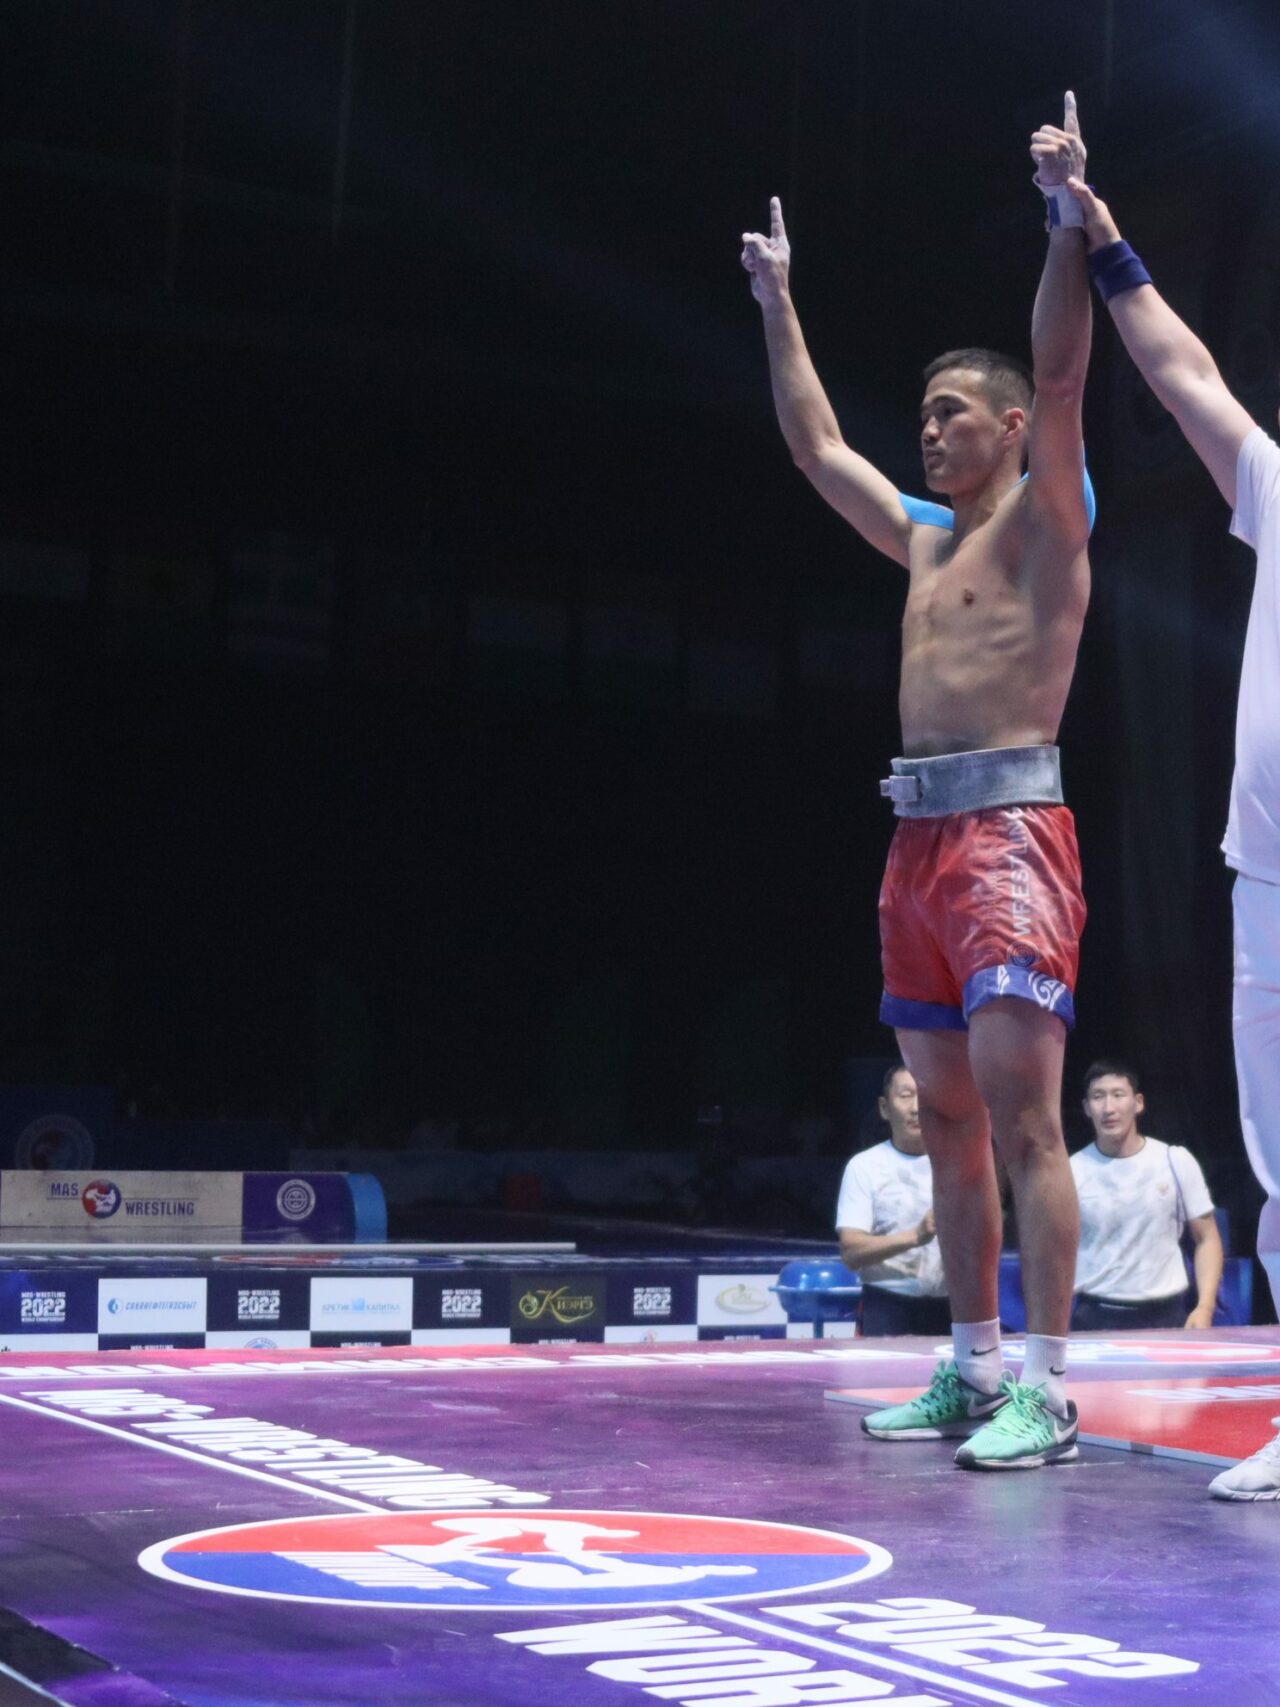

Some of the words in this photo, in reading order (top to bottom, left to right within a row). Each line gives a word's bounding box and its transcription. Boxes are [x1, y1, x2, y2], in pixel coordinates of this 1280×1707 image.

[51, 1182, 79, 1196] MAS
[126, 1201, 195, 1216] WRESTLING
[21, 1298, 66, 1317] 2022
[238, 1296, 280, 1314] 2022
[442, 1295, 482, 1313] 2022
[633, 1293, 671, 1310] 2022
[757, 1597, 1201, 1688] 2022
